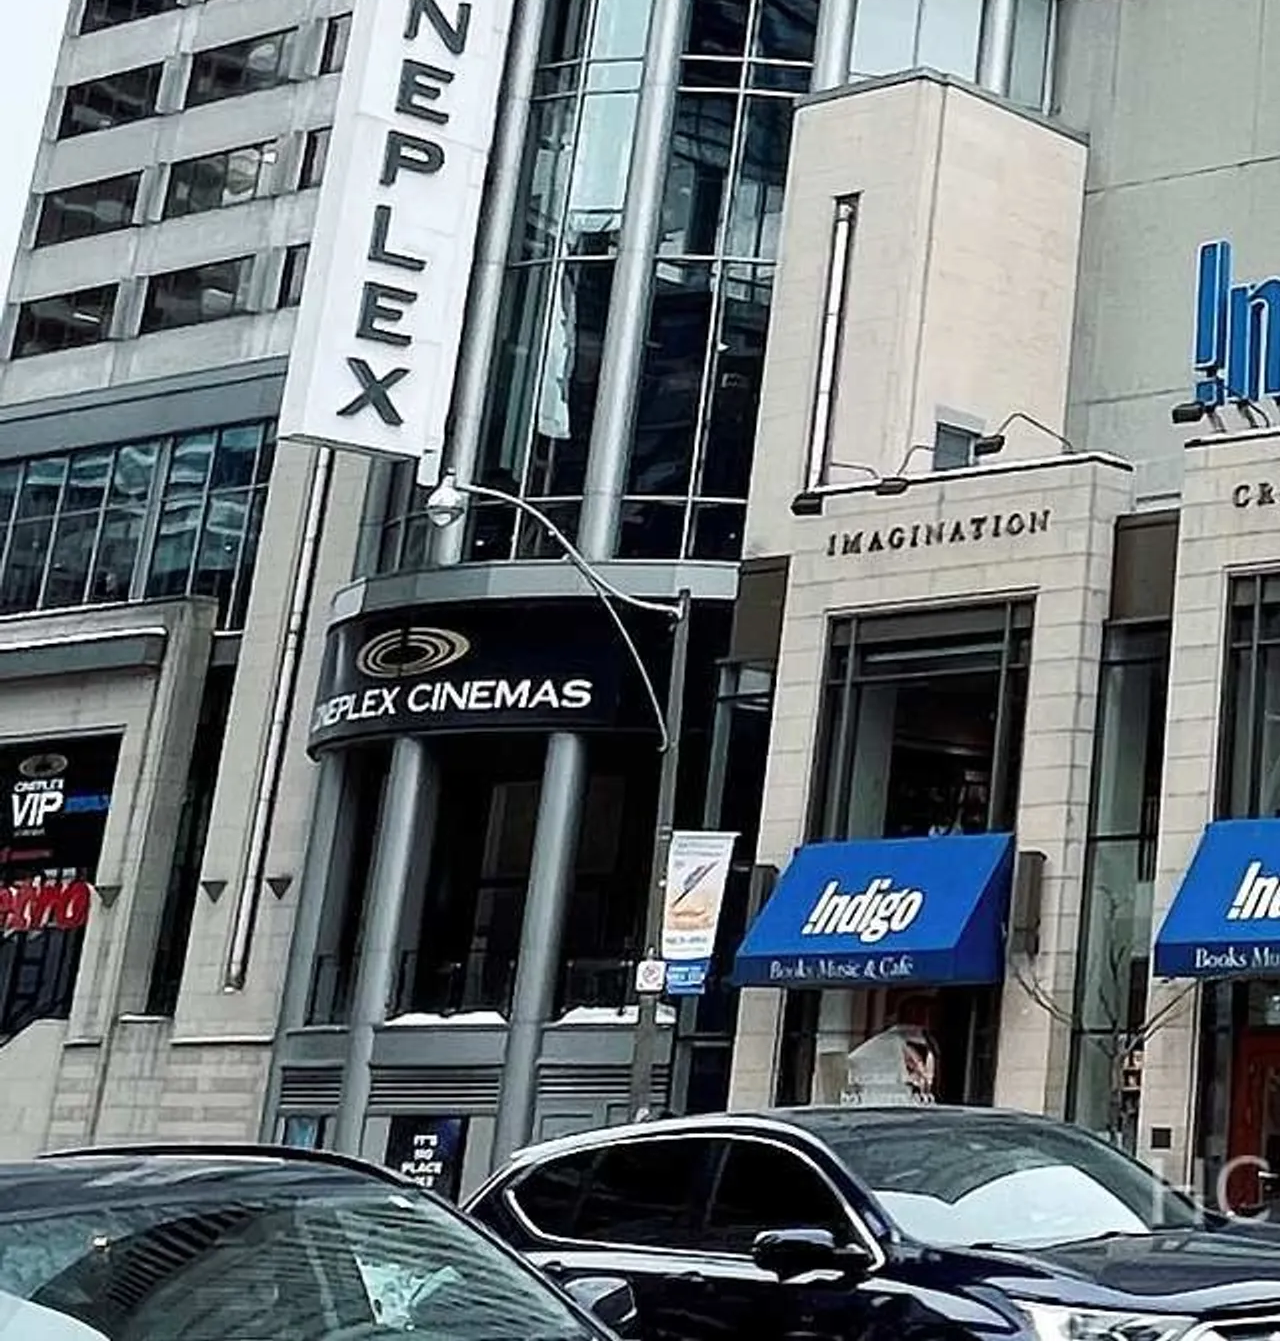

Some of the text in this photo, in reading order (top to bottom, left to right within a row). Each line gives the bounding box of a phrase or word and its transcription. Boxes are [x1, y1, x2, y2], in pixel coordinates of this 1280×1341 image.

[826, 509, 1051, 556] IMAGINATION
[407, 679, 593, 711] CINEMAS
[12, 791, 64, 827] VIP
[801, 877, 924, 943] Indigo
[1195, 945, 1248, 969] Books
